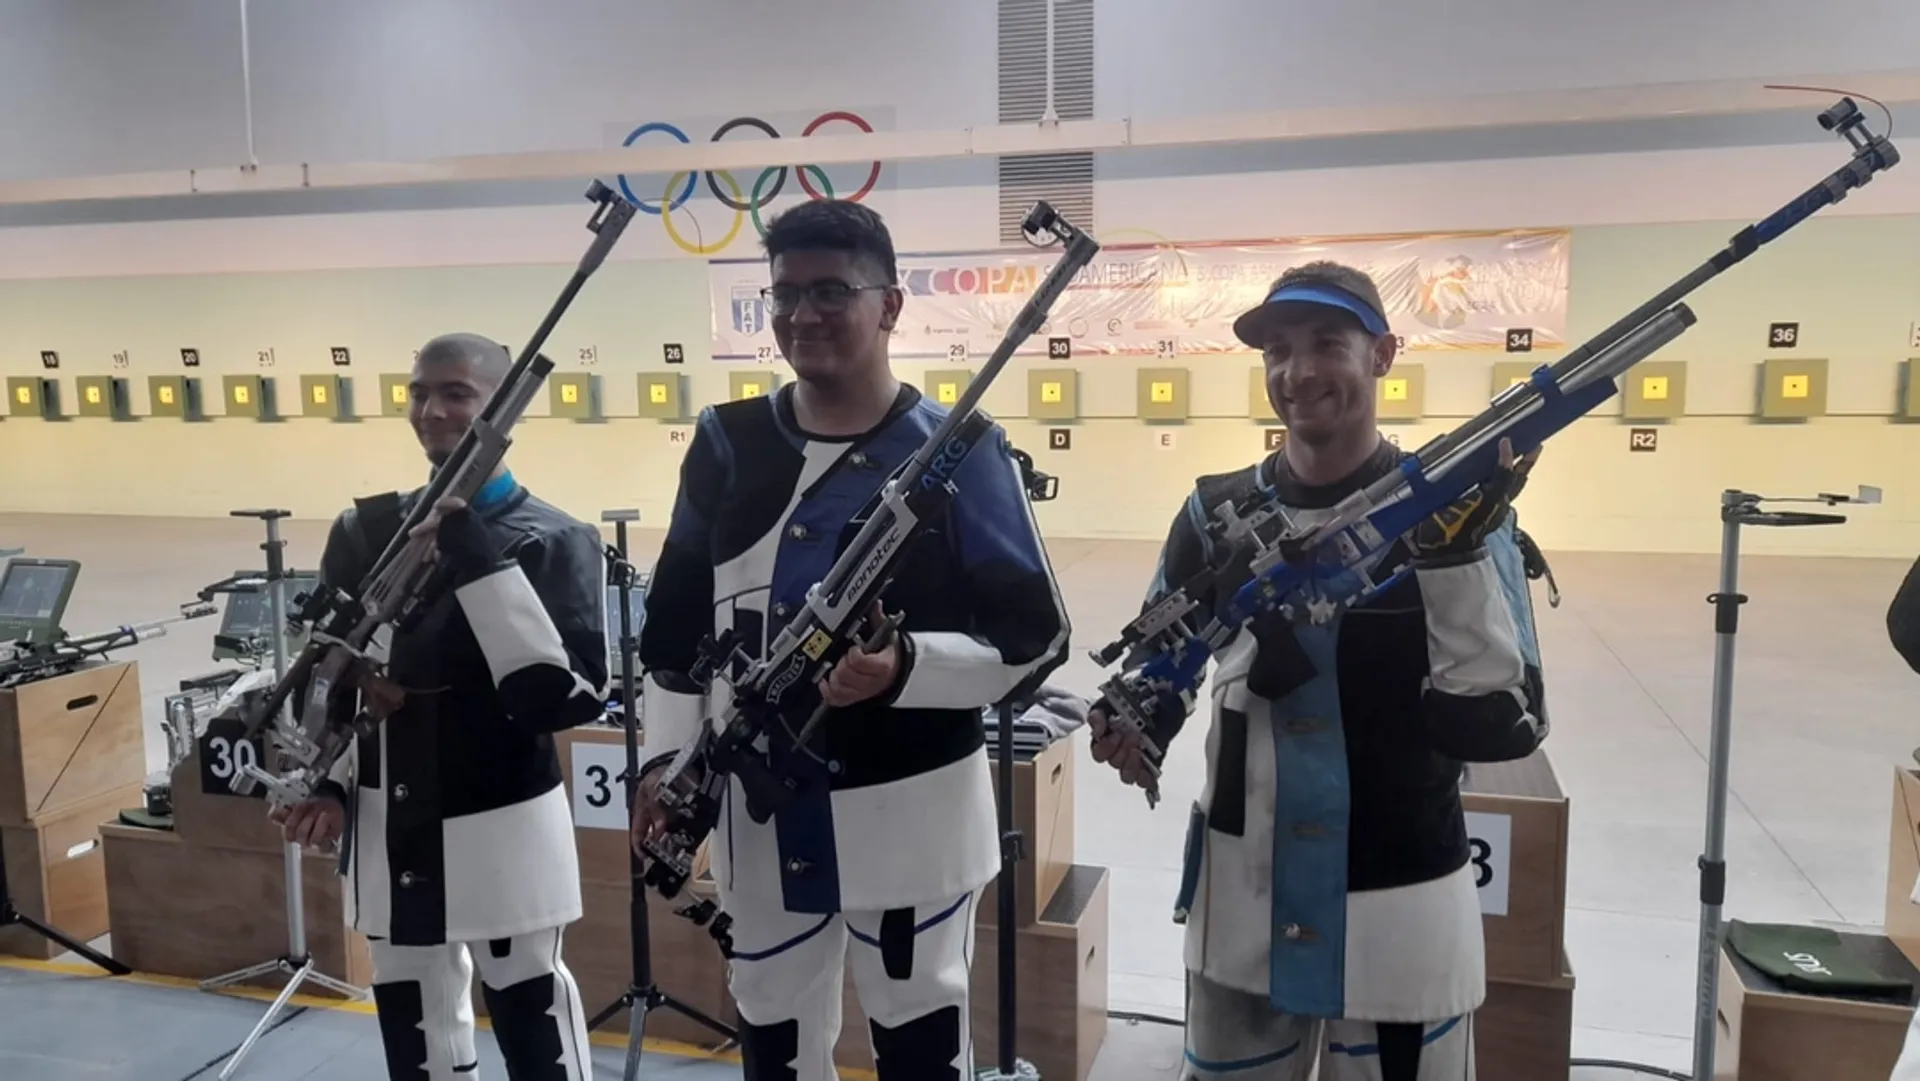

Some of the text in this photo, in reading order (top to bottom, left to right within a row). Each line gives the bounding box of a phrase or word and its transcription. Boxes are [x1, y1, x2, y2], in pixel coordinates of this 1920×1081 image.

[927, 265, 1034, 297] COPA
[1509, 334, 1529, 347] 34
[1772, 328, 1795, 342] 36
[758, 347, 771, 358] 27
[949, 344, 965, 356] 29
[1050, 342, 1068, 354] 30
[1158, 341, 1174, 352] 31
[112, 353, 124, 364] 19
[257, 351, 270, 362] 21
[334, 350, 347, 362] 22
[579, 348, 593, 360] 25
[666, 348, 681, 359] 26
[670, 431, 686, 442] R1
[1055, 433, 1066, 446] D
[1161, 433, 1170, 446] E
[1271, 433, 1282, 446] F
[1632, 434, 1655, 447] R2
[921, 437, 967, 490] ARG
[209, 736, 257, 779] 30
